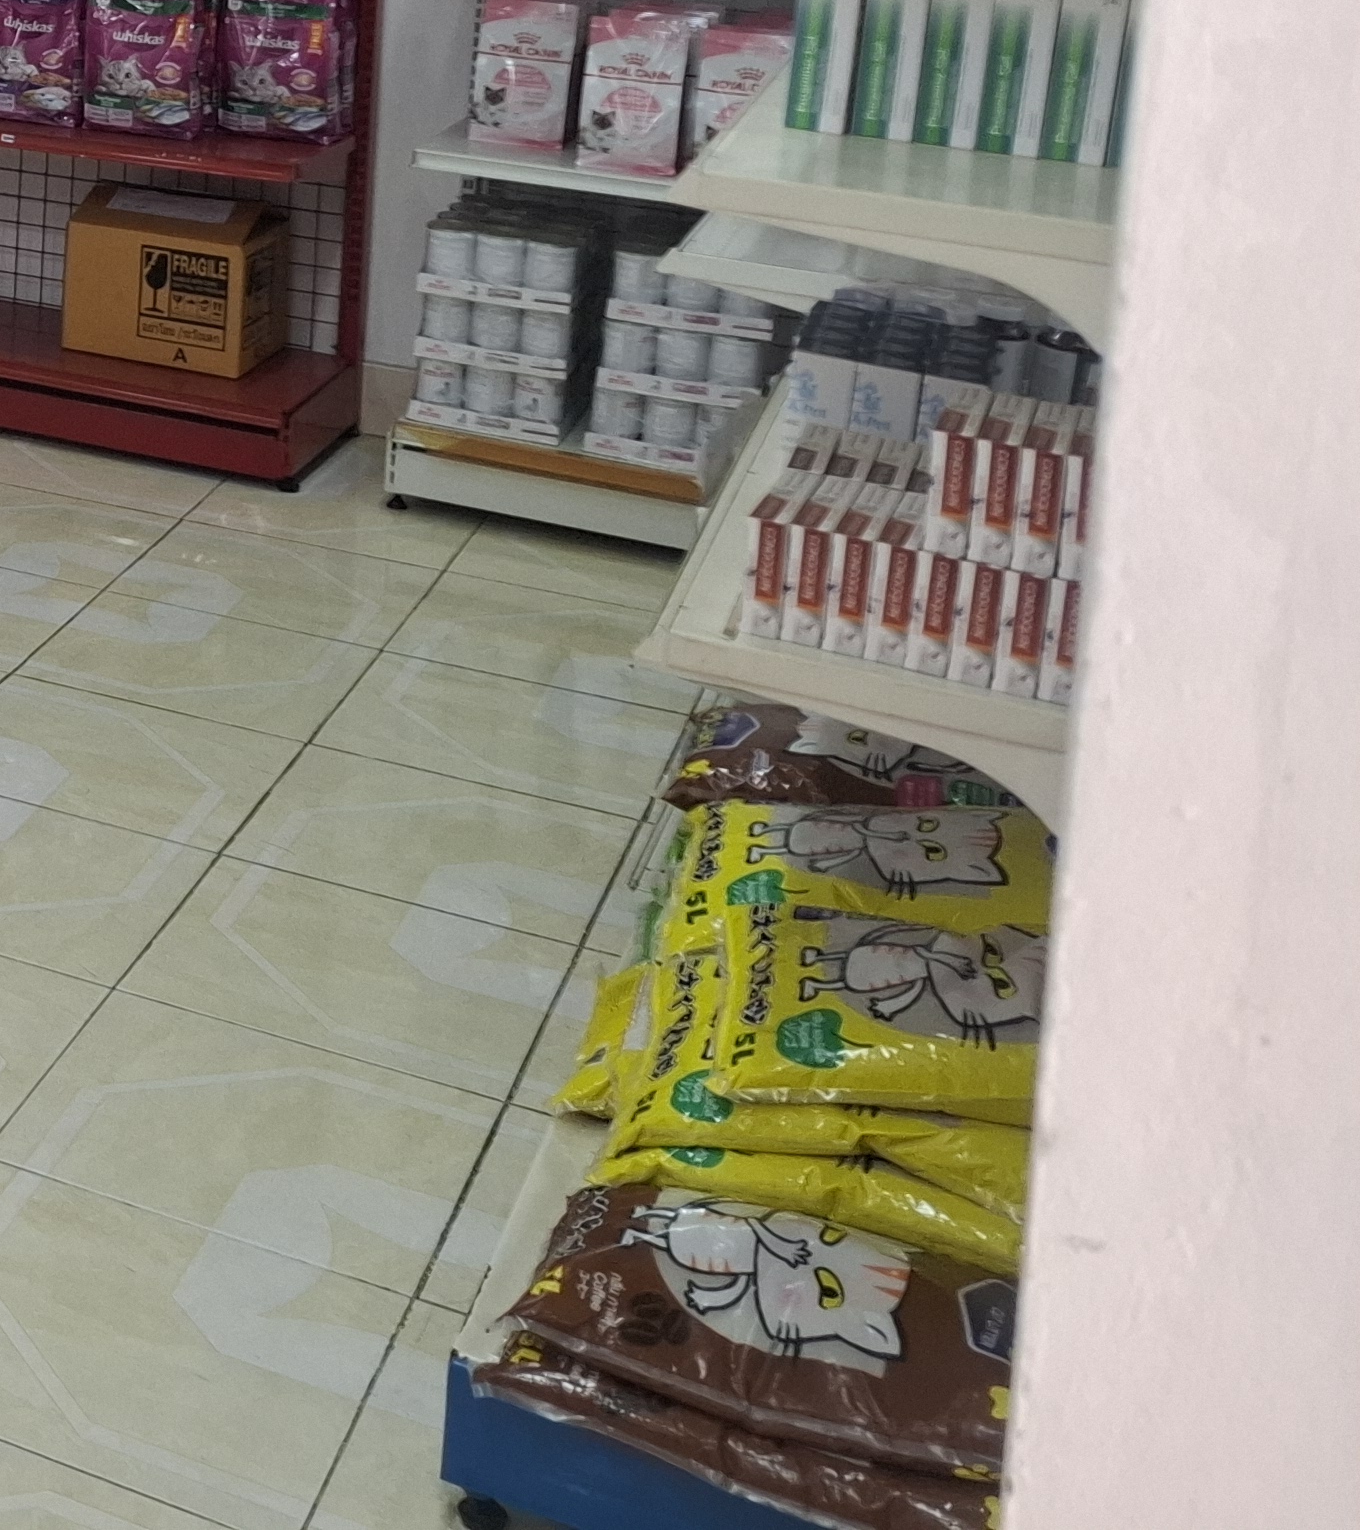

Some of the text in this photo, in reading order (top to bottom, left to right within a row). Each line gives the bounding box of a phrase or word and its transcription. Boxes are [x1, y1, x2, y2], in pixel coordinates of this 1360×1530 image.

[4, 16, 56, 33] whiskas
[111, 30, 165, 45] whiskas
[173, 254, 228, 280] FRAGILE
[172, 347, 188, 363] A
[685, 890, 708, 925] 5L
[731, 1032, 756, 1067] 5L
